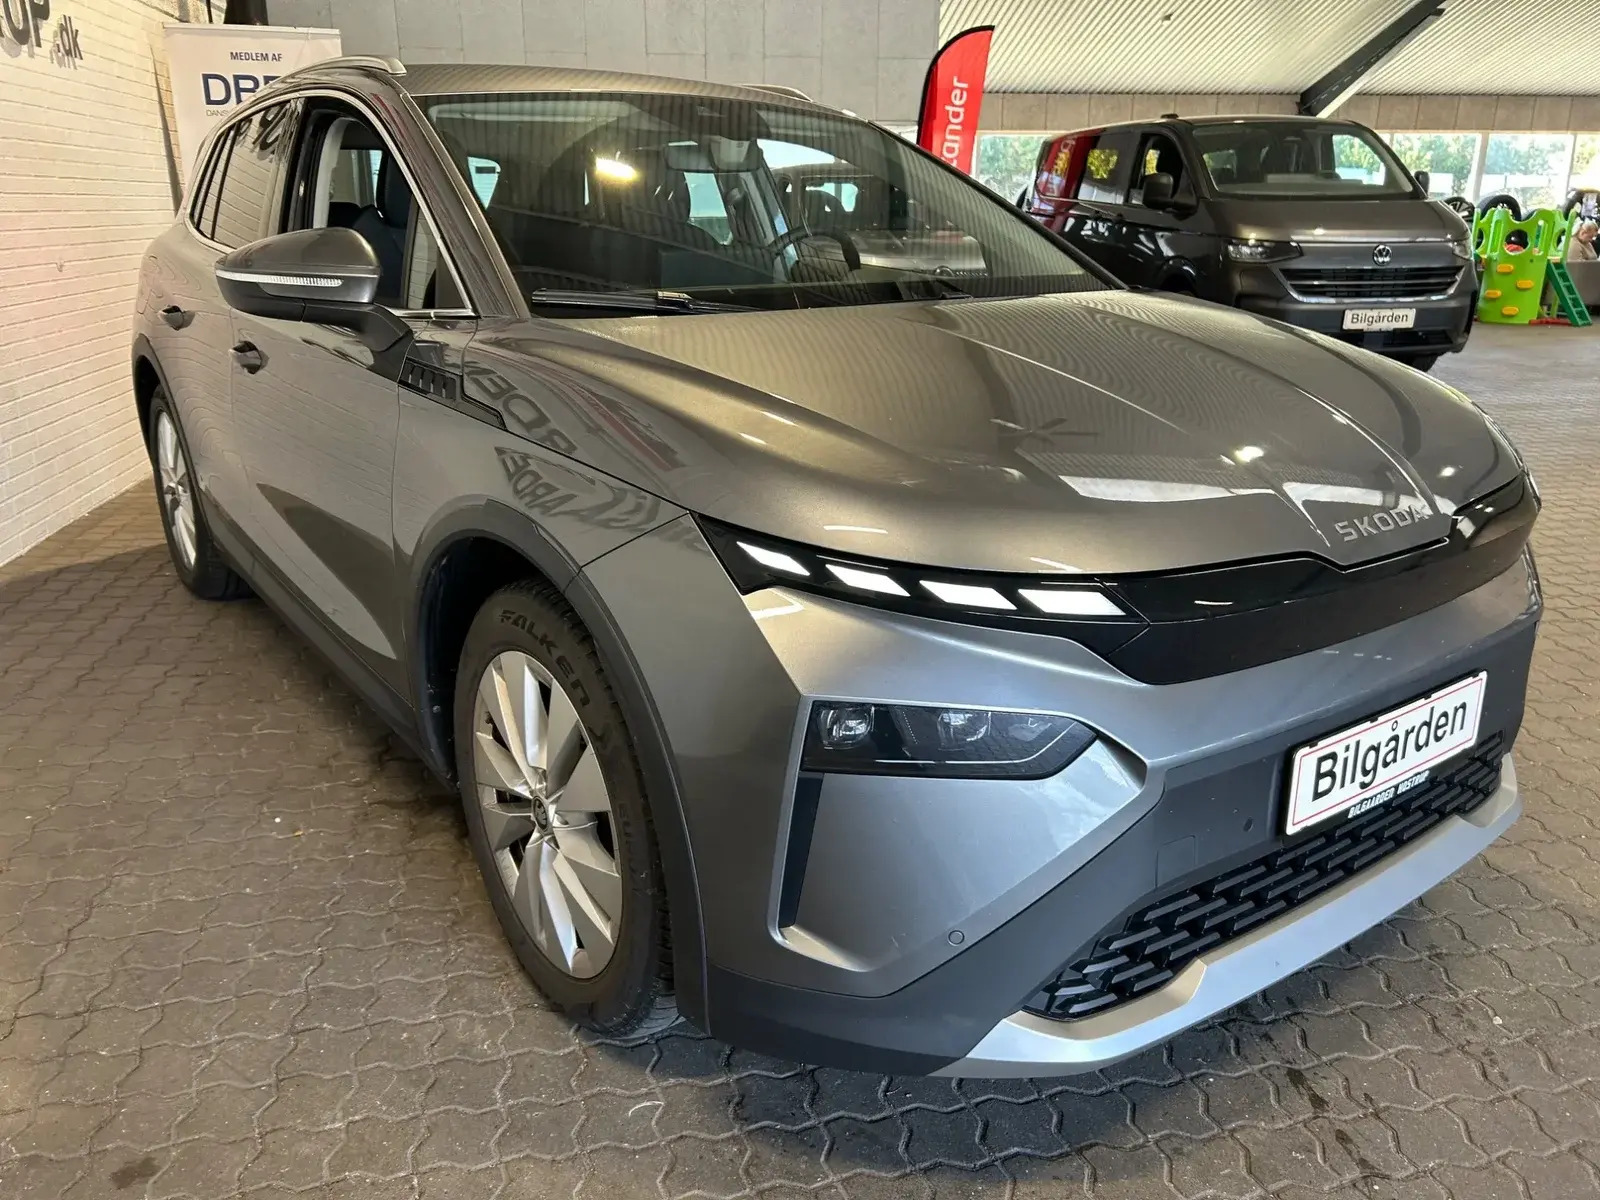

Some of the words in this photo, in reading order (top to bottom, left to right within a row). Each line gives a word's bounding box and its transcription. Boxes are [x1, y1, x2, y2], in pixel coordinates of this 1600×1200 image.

[230, 51, 269, 62] MEDLEM
[271, 53, 283, 62] AF
[1351, 310, 1408, 326] Bilgården
[500, 610, 590, 706] FALKEN
[1312, 700, 1467, 803] Bilgården
